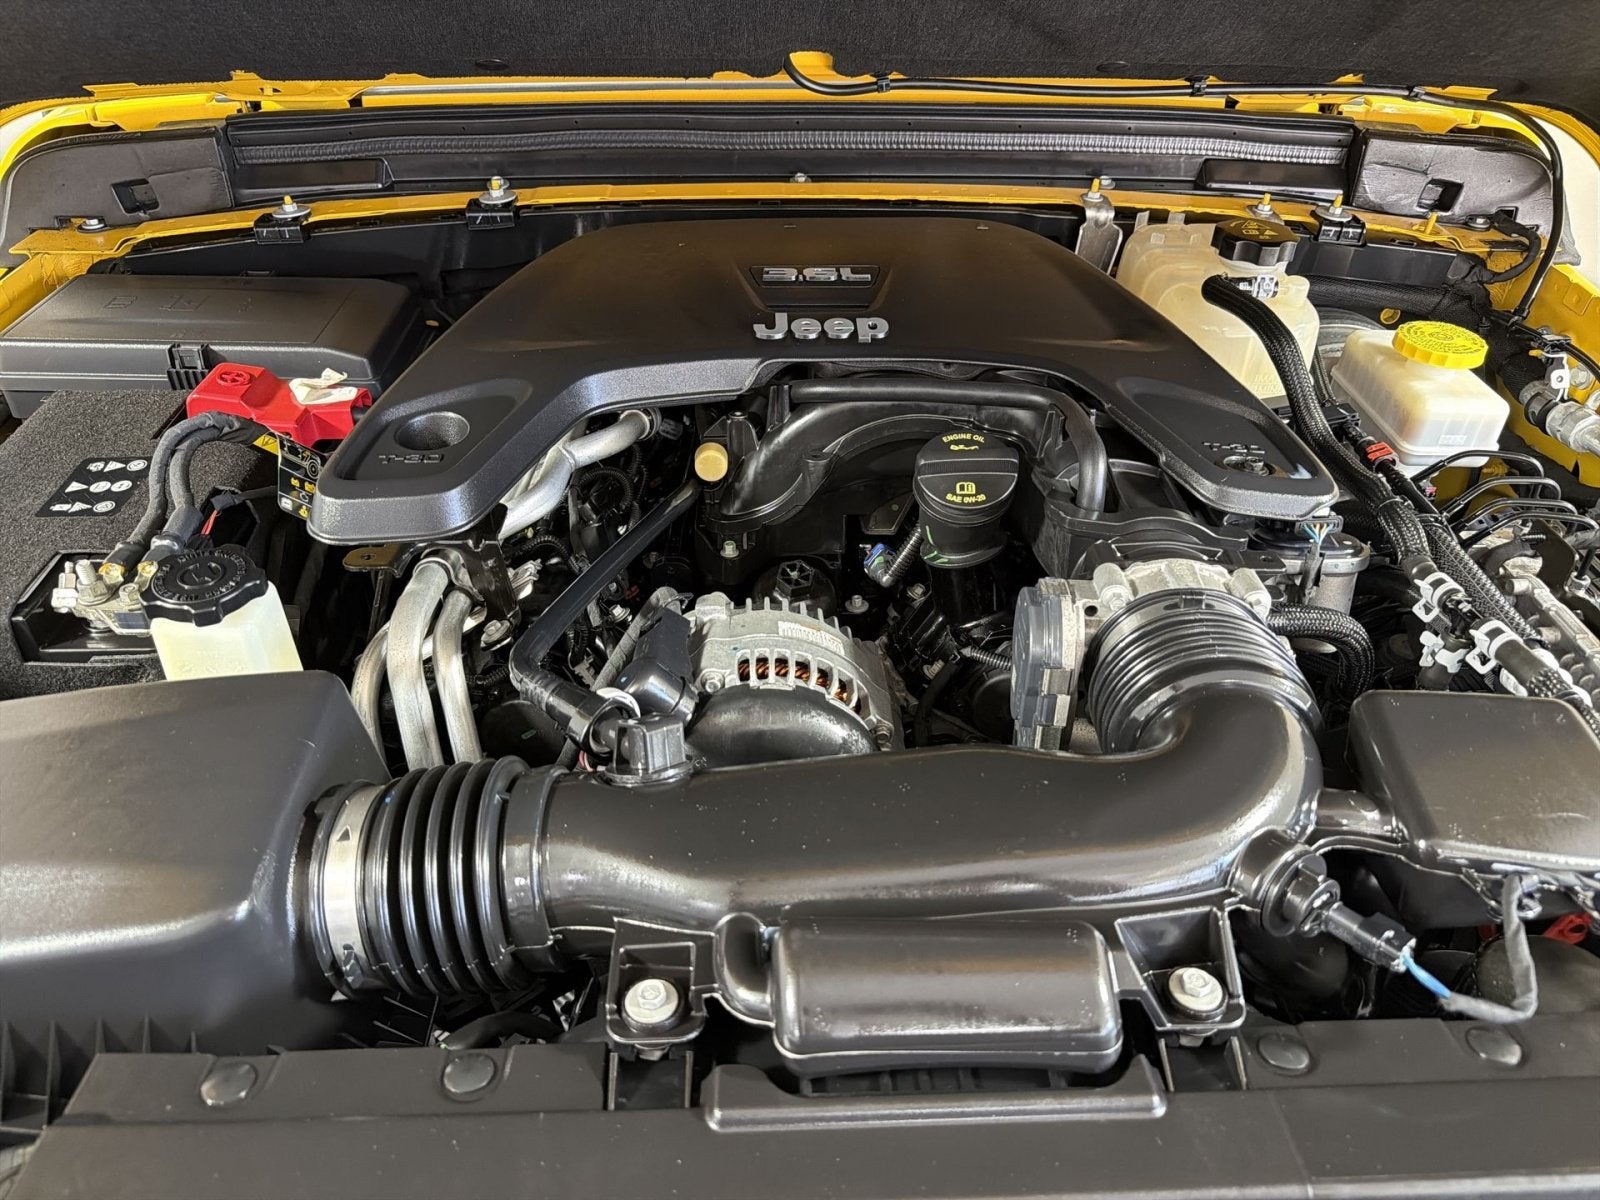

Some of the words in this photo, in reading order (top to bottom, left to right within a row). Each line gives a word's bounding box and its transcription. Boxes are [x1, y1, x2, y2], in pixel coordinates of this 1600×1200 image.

[763, 267, 872, 281] 3.6L
[753, 312, 889, 343] Jeep
[942, 433, 972, 443] ENGINE
[973, 434, 985, 443] OIL
[945, 493, 962, 503] SAE
[963, 493, 986, 504] 0W-20
